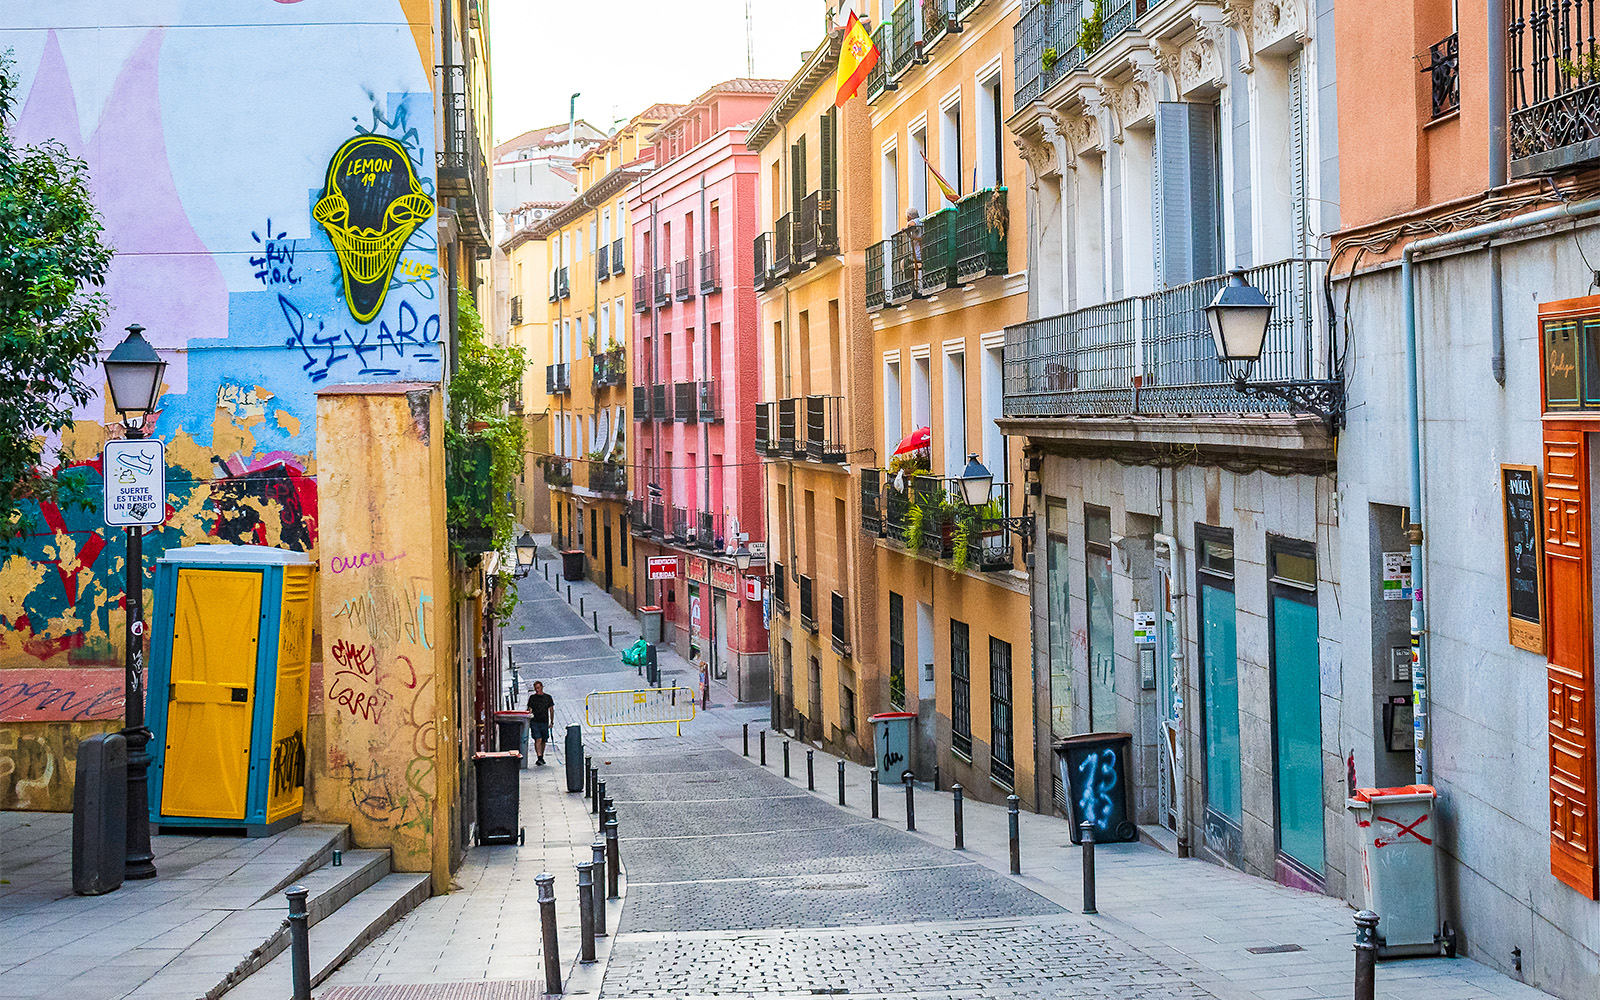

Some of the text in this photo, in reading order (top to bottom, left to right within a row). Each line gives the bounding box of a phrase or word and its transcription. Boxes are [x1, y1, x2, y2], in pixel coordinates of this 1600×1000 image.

[346, 158, 393, 176] LEMON
[361, 173, 377, 187] 19
[120, 487, 149, 495] SUERTE
[113, 502, 157, 511] UN BRIO
